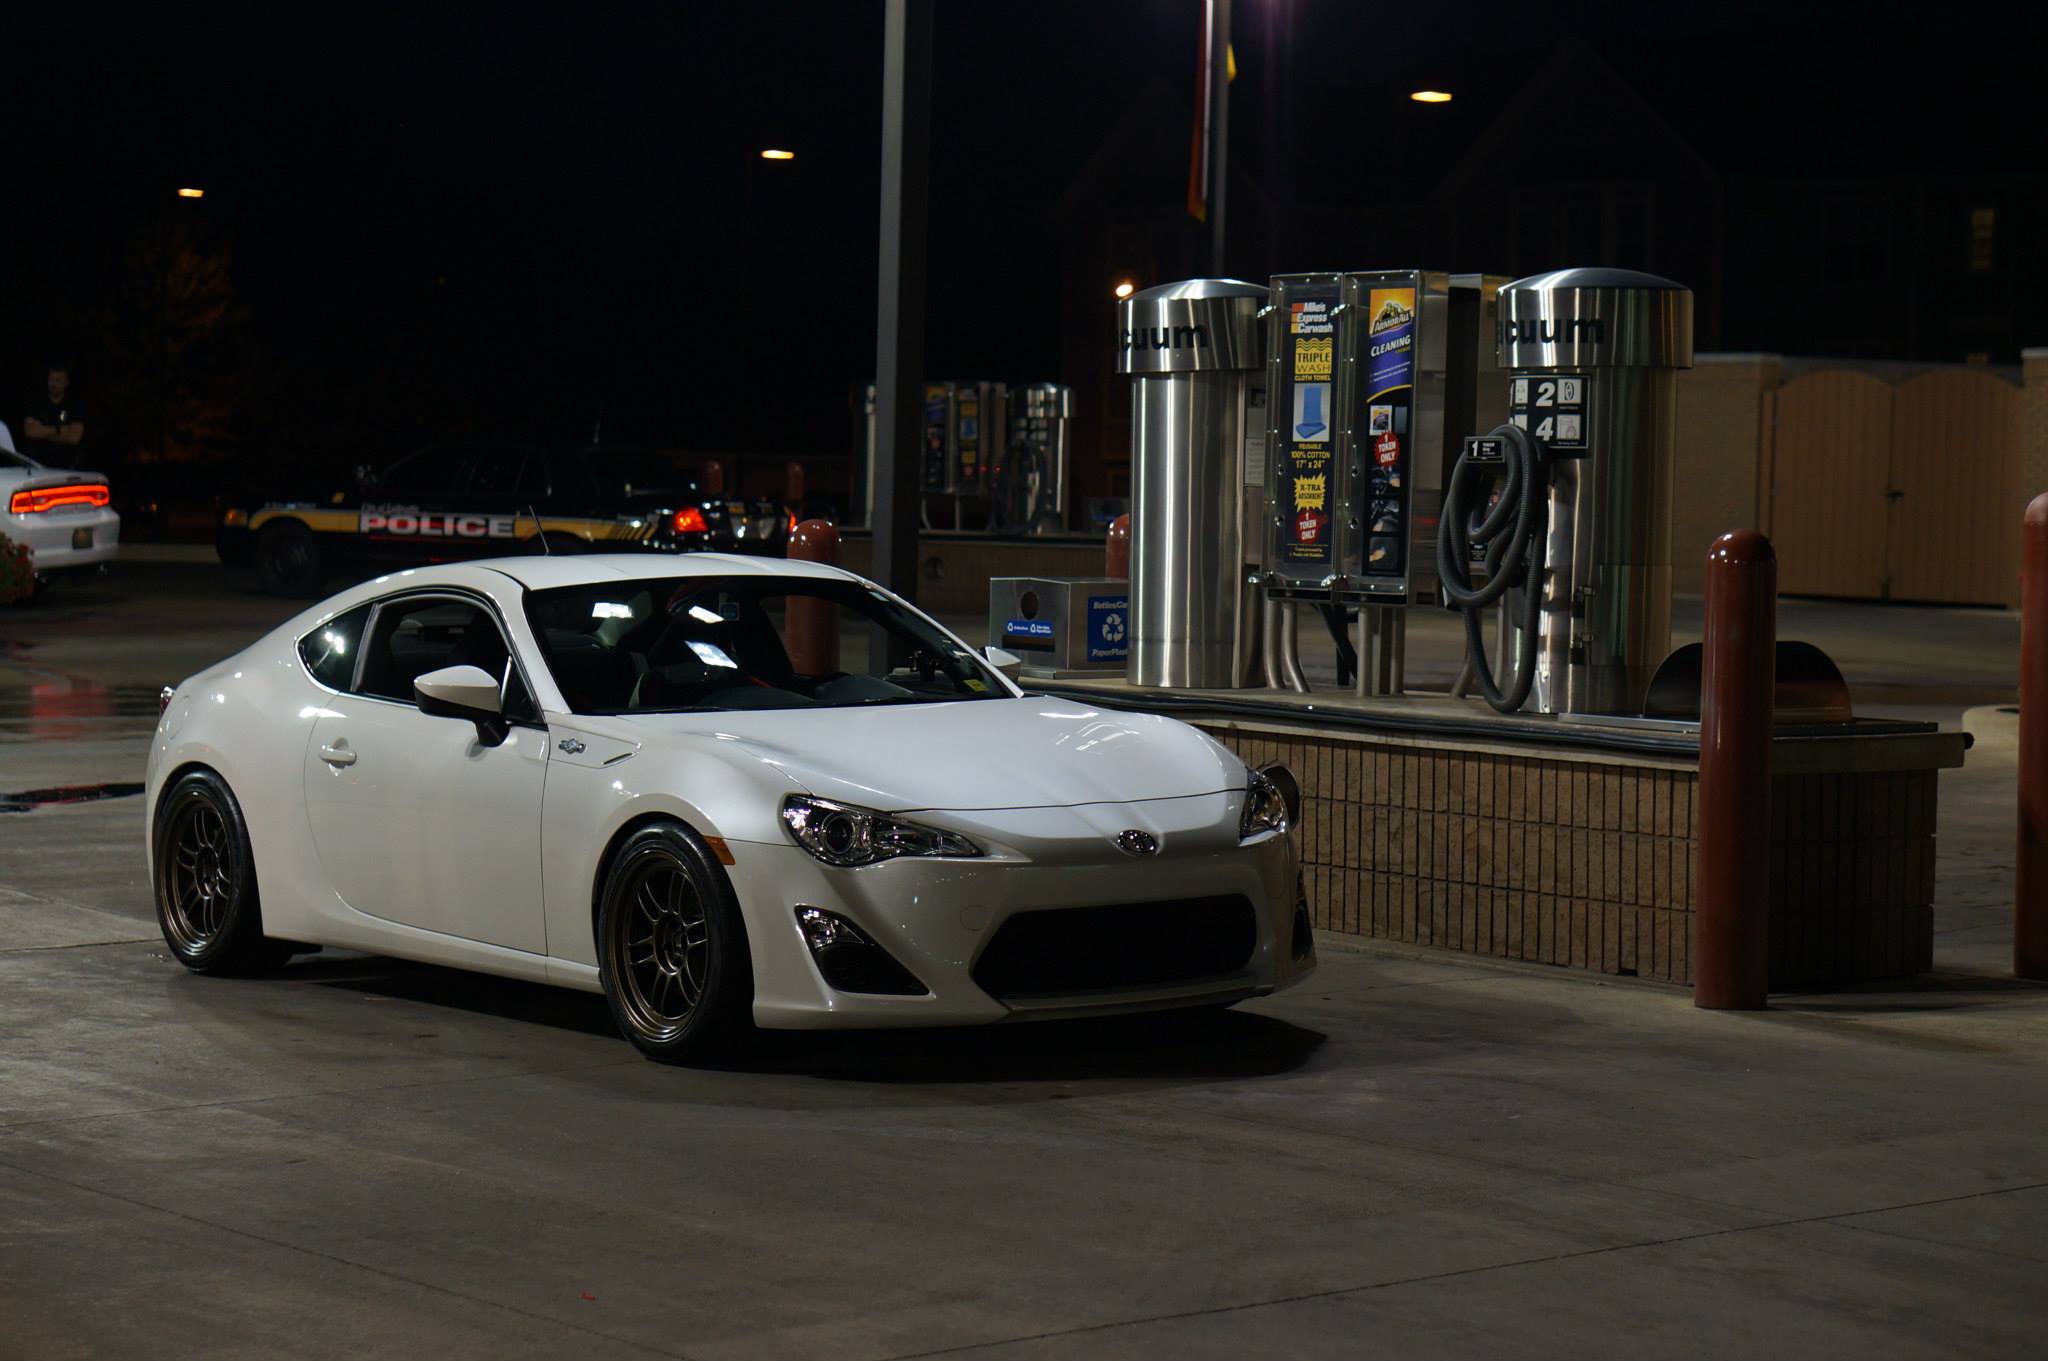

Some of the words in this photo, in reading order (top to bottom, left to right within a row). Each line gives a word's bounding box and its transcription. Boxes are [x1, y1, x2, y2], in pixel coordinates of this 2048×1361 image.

[1297, 312, 1328, 324] Express
[1116, 325, 1208, 351] cuum
[1499, 319, 1603, 344] cuum
[1370, 334, 1412, 357] CLEANING
[1297, 352, 1330, 362] TRIPLE
[1296, 363, 1331, 373] WASH
[1535, 381, 1556, 407] 2
[1535, 416, 1554, 441] 4
[1307, 451, 1331, 459] COTTON
[1380, 451, 1396, 464] ONLY
[1472, 441, 1479, 457] 1
[360, 513, 514, 538] POLICE
